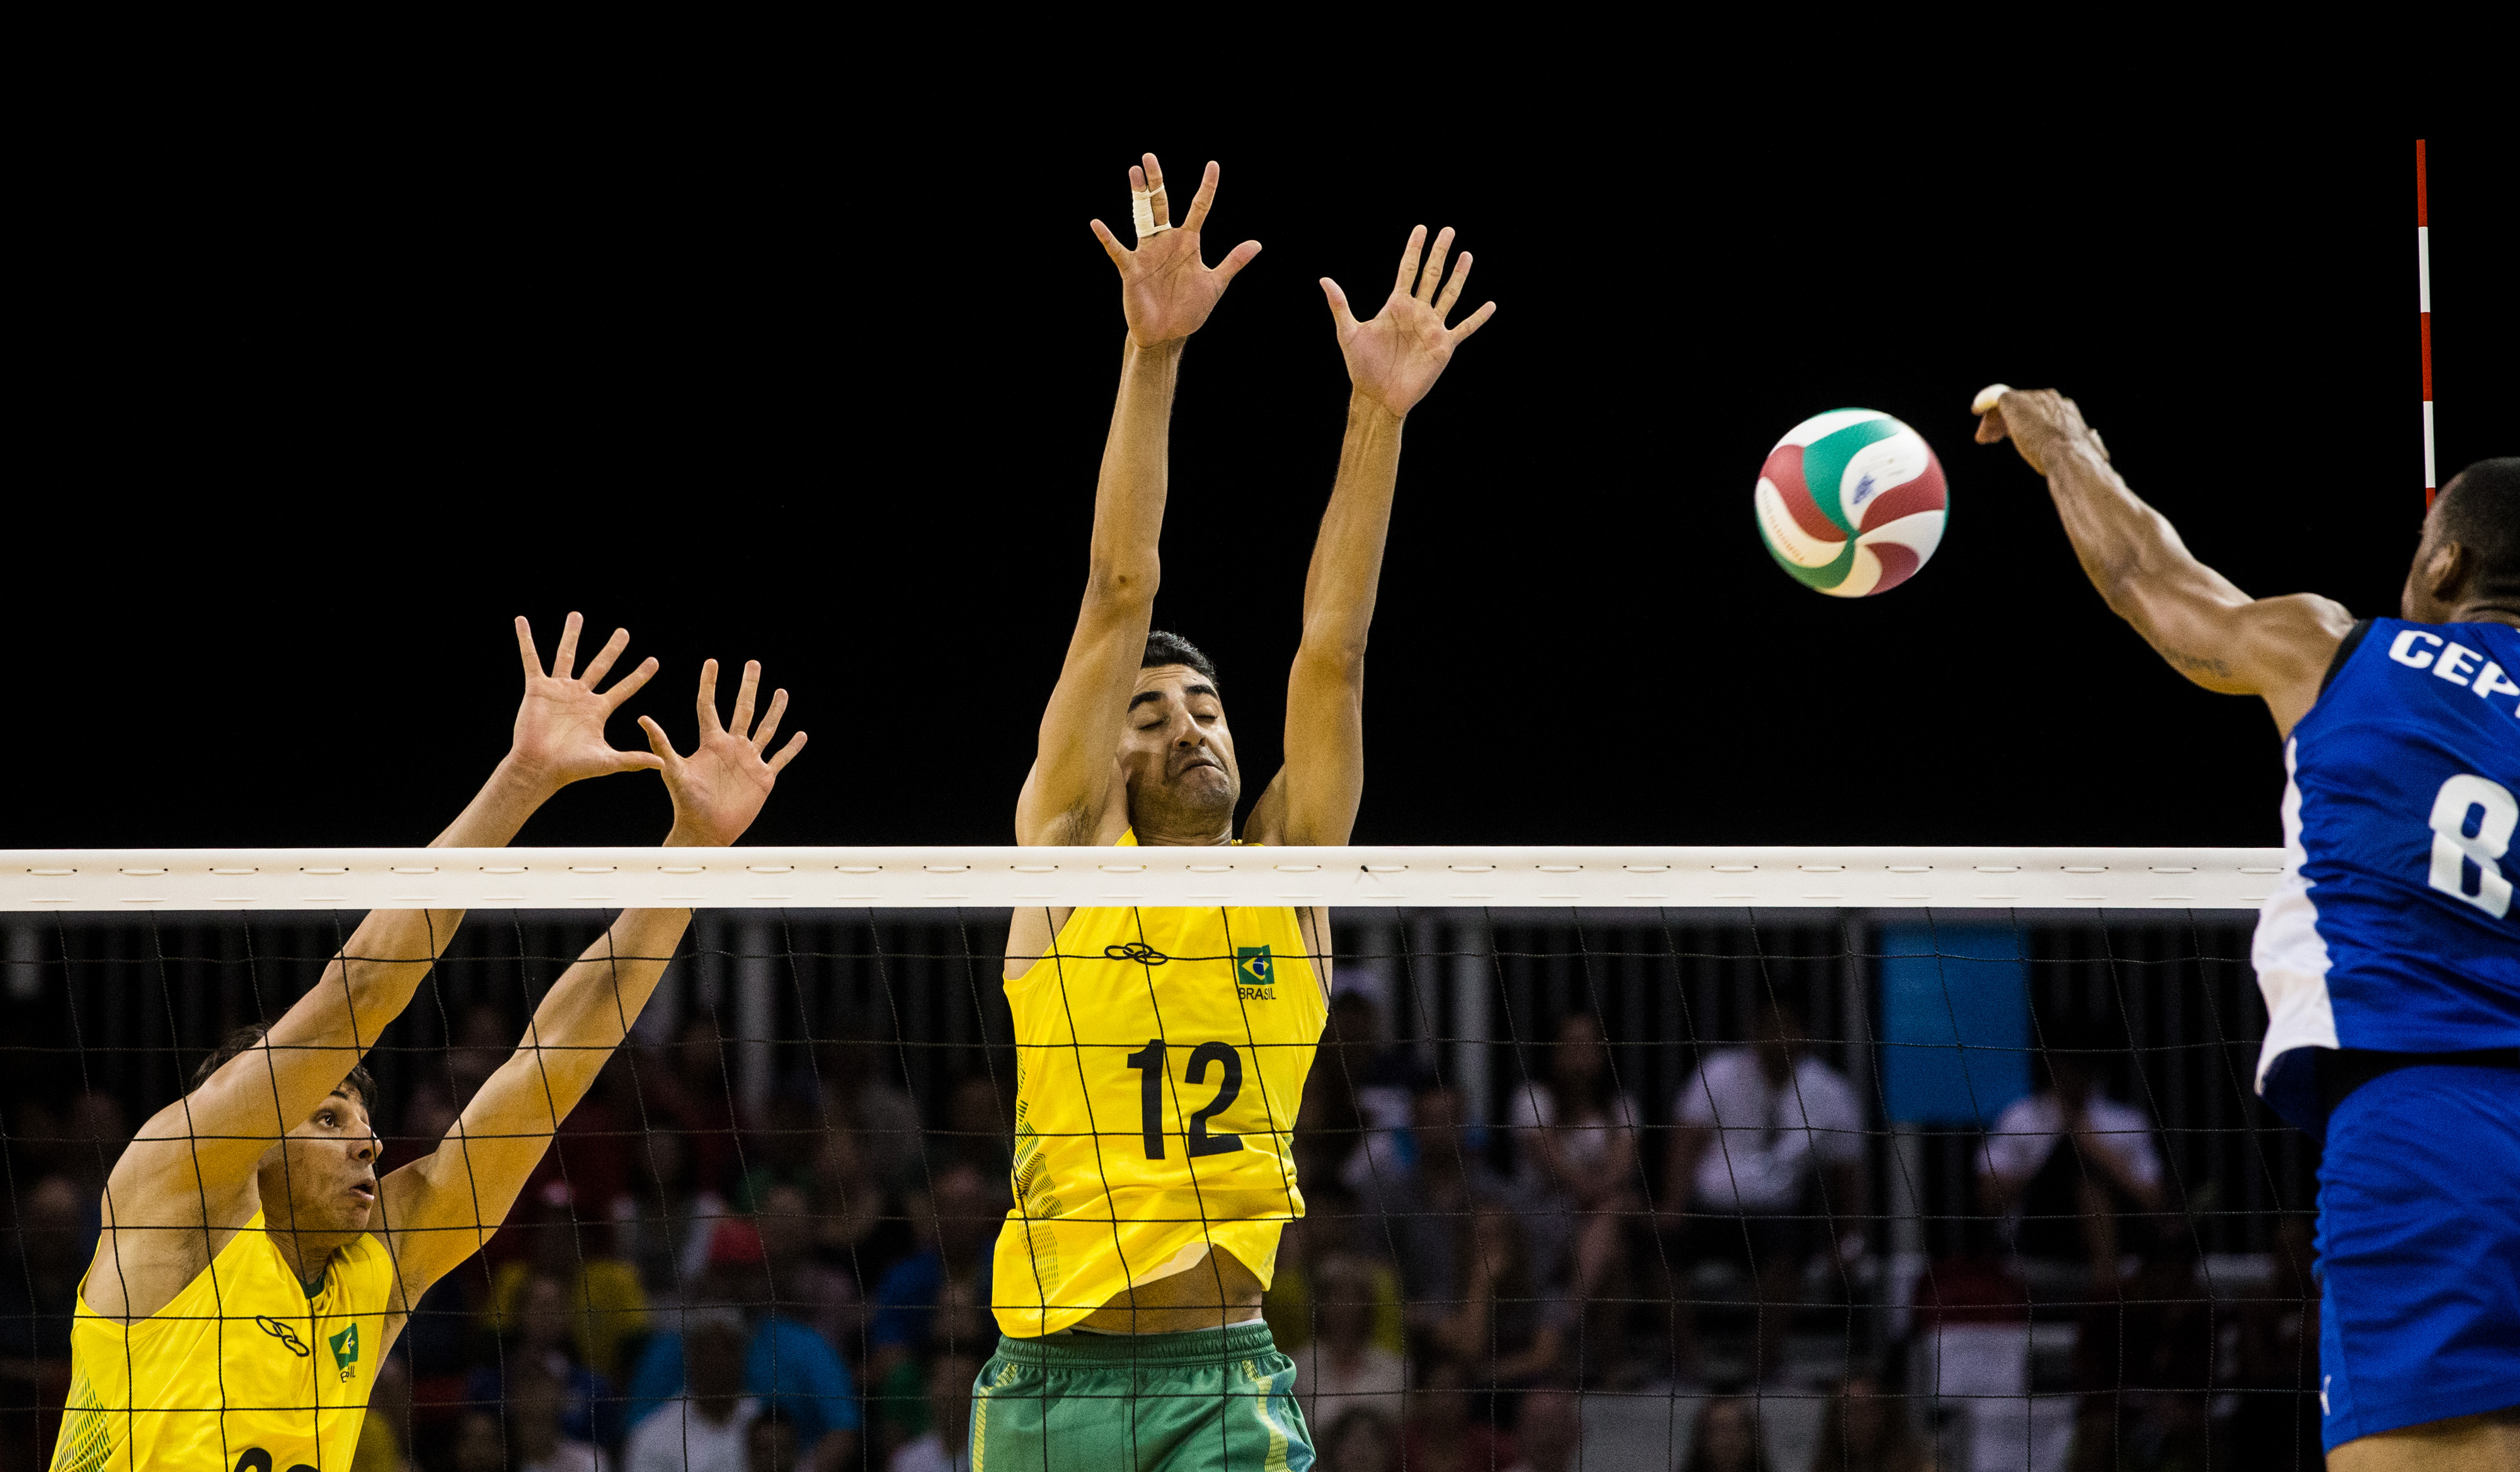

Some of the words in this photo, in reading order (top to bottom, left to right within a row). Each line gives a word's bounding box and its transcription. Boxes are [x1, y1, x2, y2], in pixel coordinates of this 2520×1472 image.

[2389, 630, 2520, 719] CEP
[2429, 774, 2519, 919] 8
[1238, 987, 1276, 1000] BRASIL
[1126, 1038, 1244, 1160] 12
